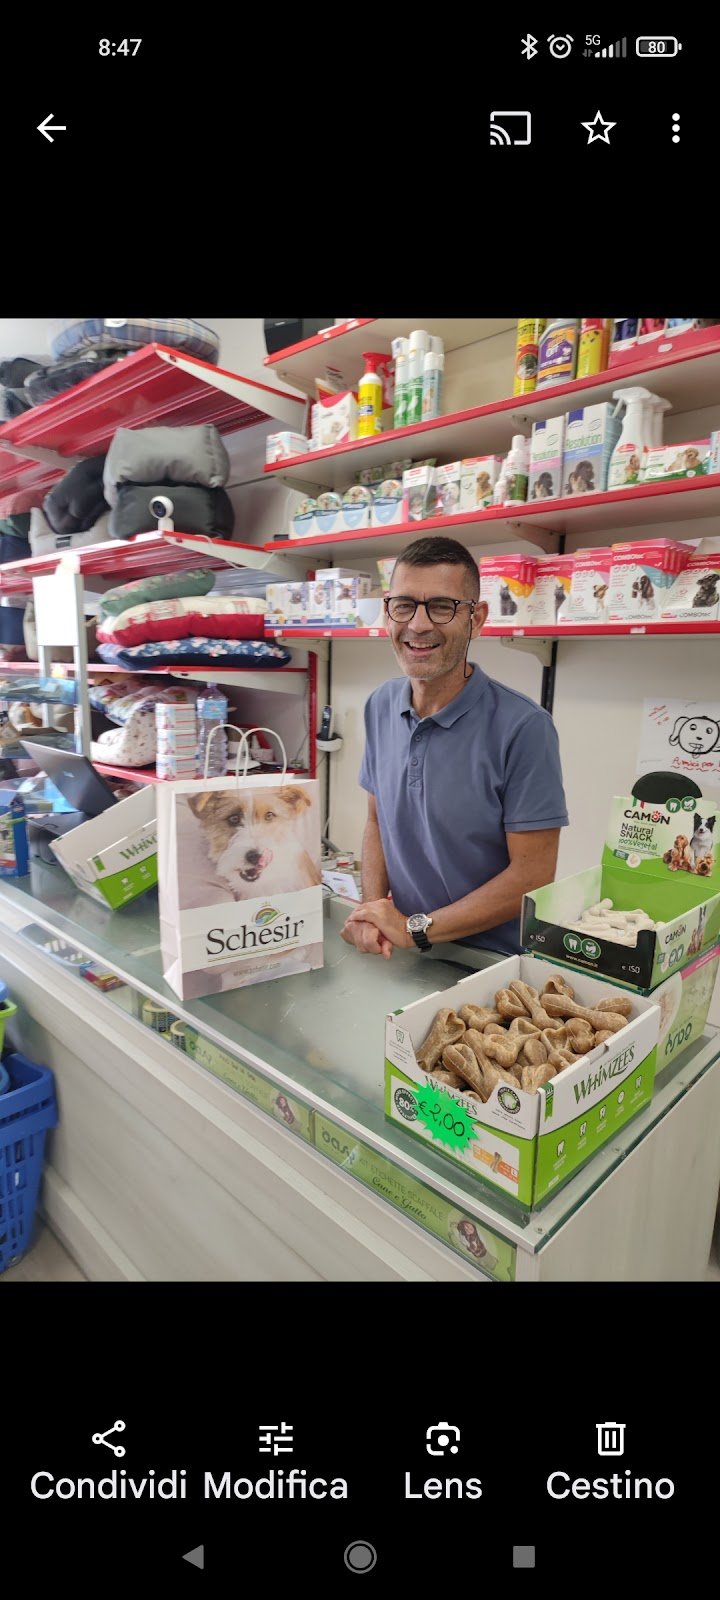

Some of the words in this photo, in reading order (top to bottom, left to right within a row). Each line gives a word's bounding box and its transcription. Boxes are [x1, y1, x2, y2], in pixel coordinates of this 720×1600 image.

[623, 809, 671, 825] CAMON
[620, 829, 652, 842] SNACK
[621, 822, 654, 835] Natural
[206, 916, 304, 955] Schesir
[664, 924, 687, 945] CAMON
